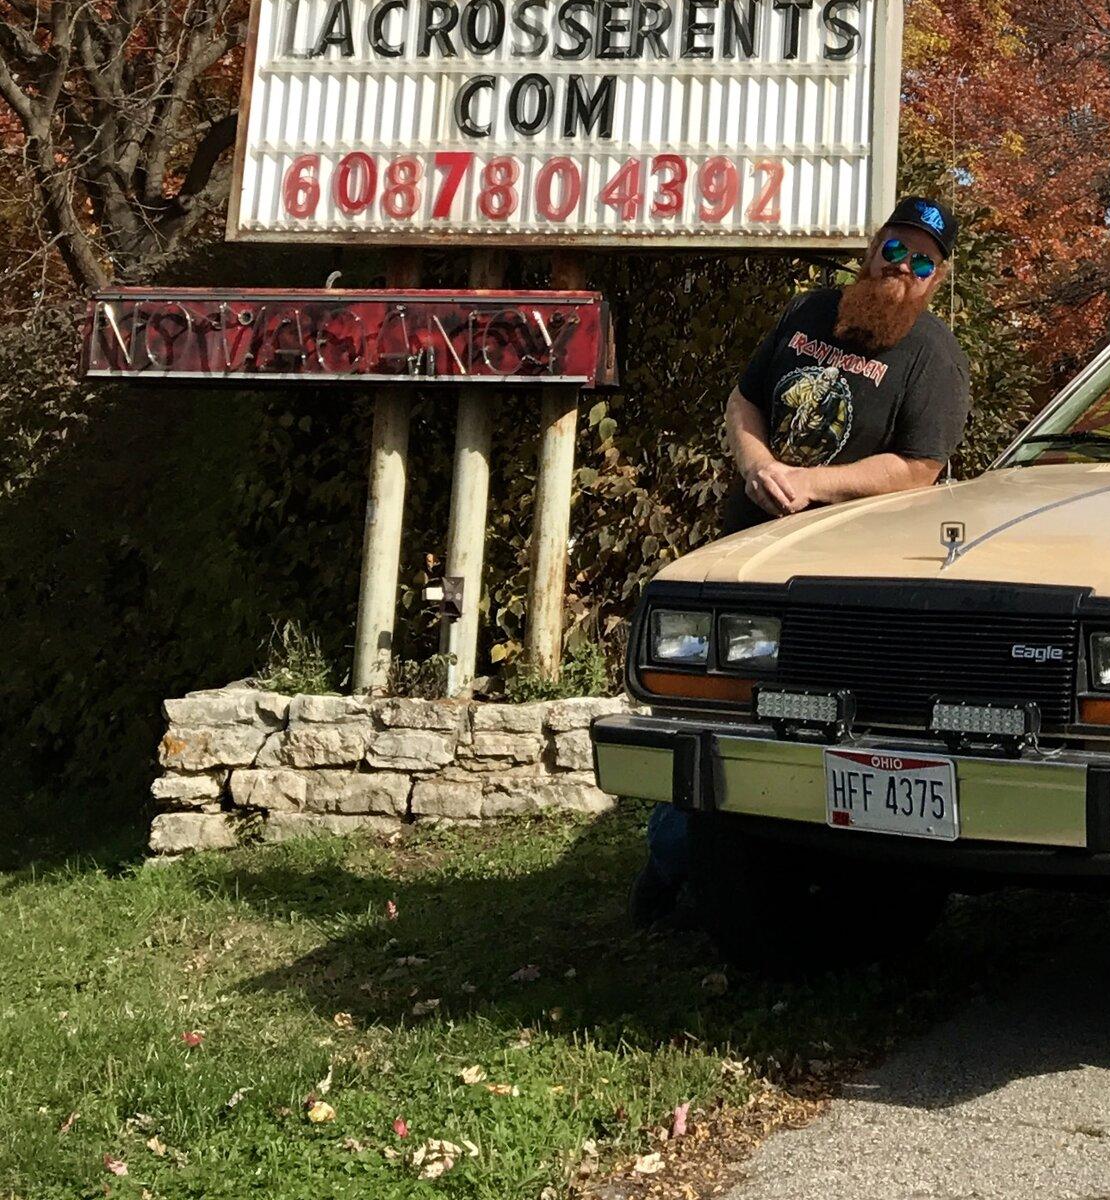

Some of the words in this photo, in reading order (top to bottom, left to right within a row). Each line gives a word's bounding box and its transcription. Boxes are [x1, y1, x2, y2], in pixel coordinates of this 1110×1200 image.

[453, 73, 616, 139] COM
[281, 151, 785, 225] 6087804392
[788, 330, 832, 366] IRON
[827, 347, 889, 388] MAIDEN
[1011, 644, 1064, 663] Eagle
[870, 756, 904, 770] OHIO
[832, 769, 875, 812] HFF
[885, 775, 945, 820] 4375
